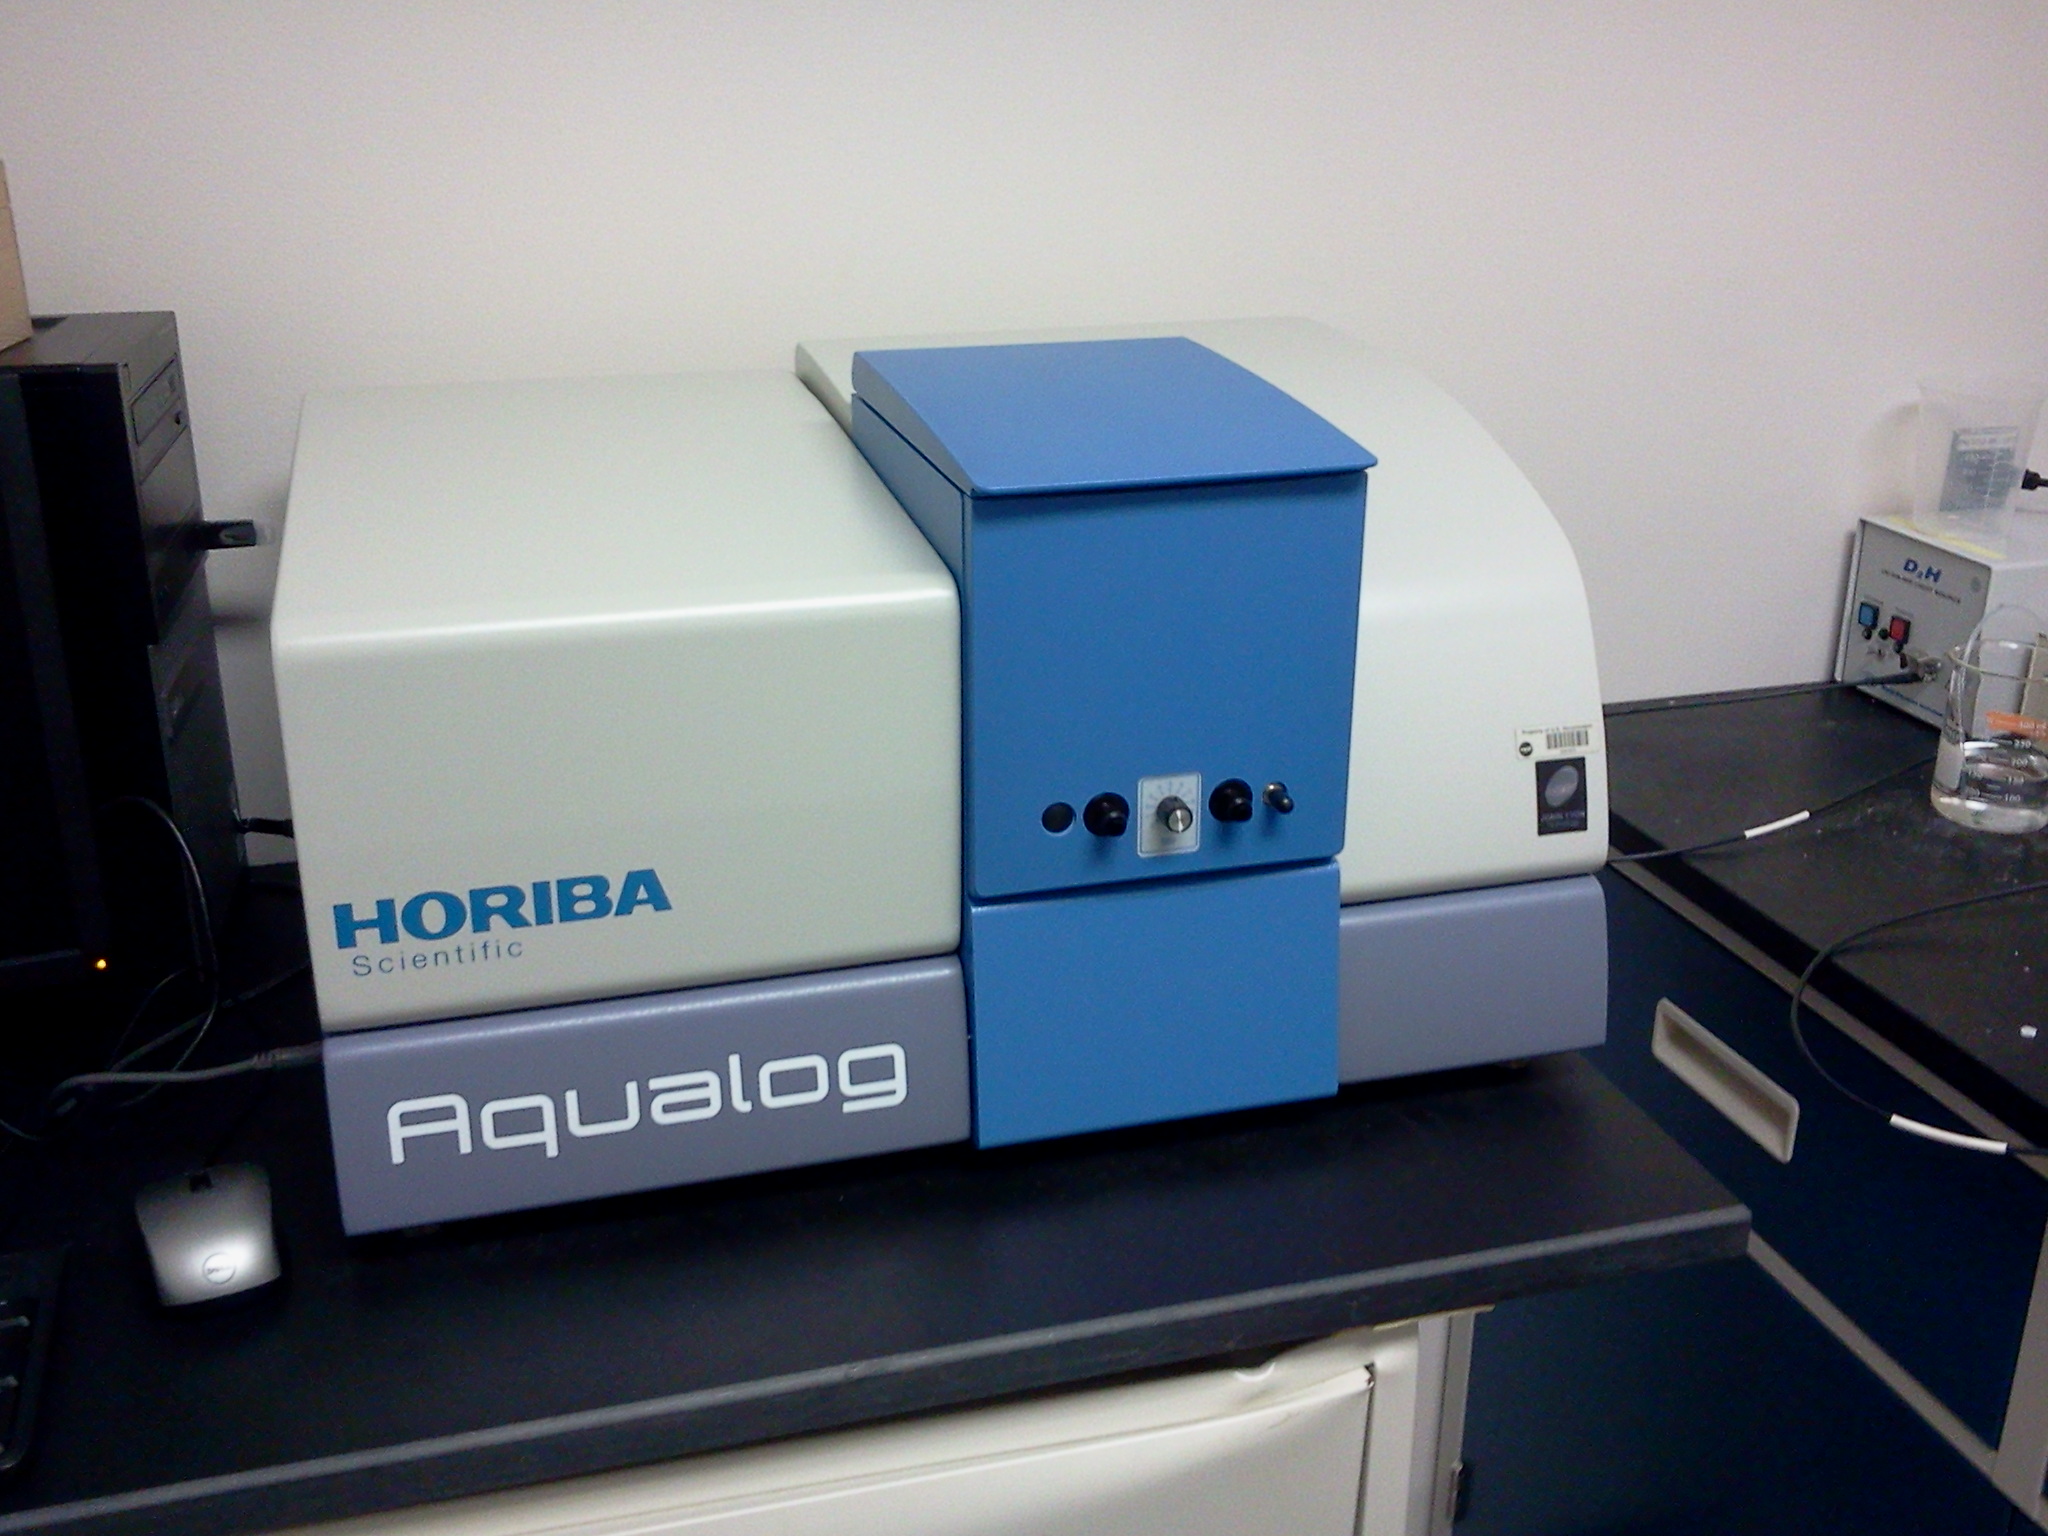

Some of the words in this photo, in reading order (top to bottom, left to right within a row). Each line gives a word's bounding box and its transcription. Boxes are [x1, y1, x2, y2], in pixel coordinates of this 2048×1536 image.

[333, 868, 672, 949] HORIBA
[352, 940, 524, 977] Scientific
[386, 1043, 908, 1165] Aqualog
